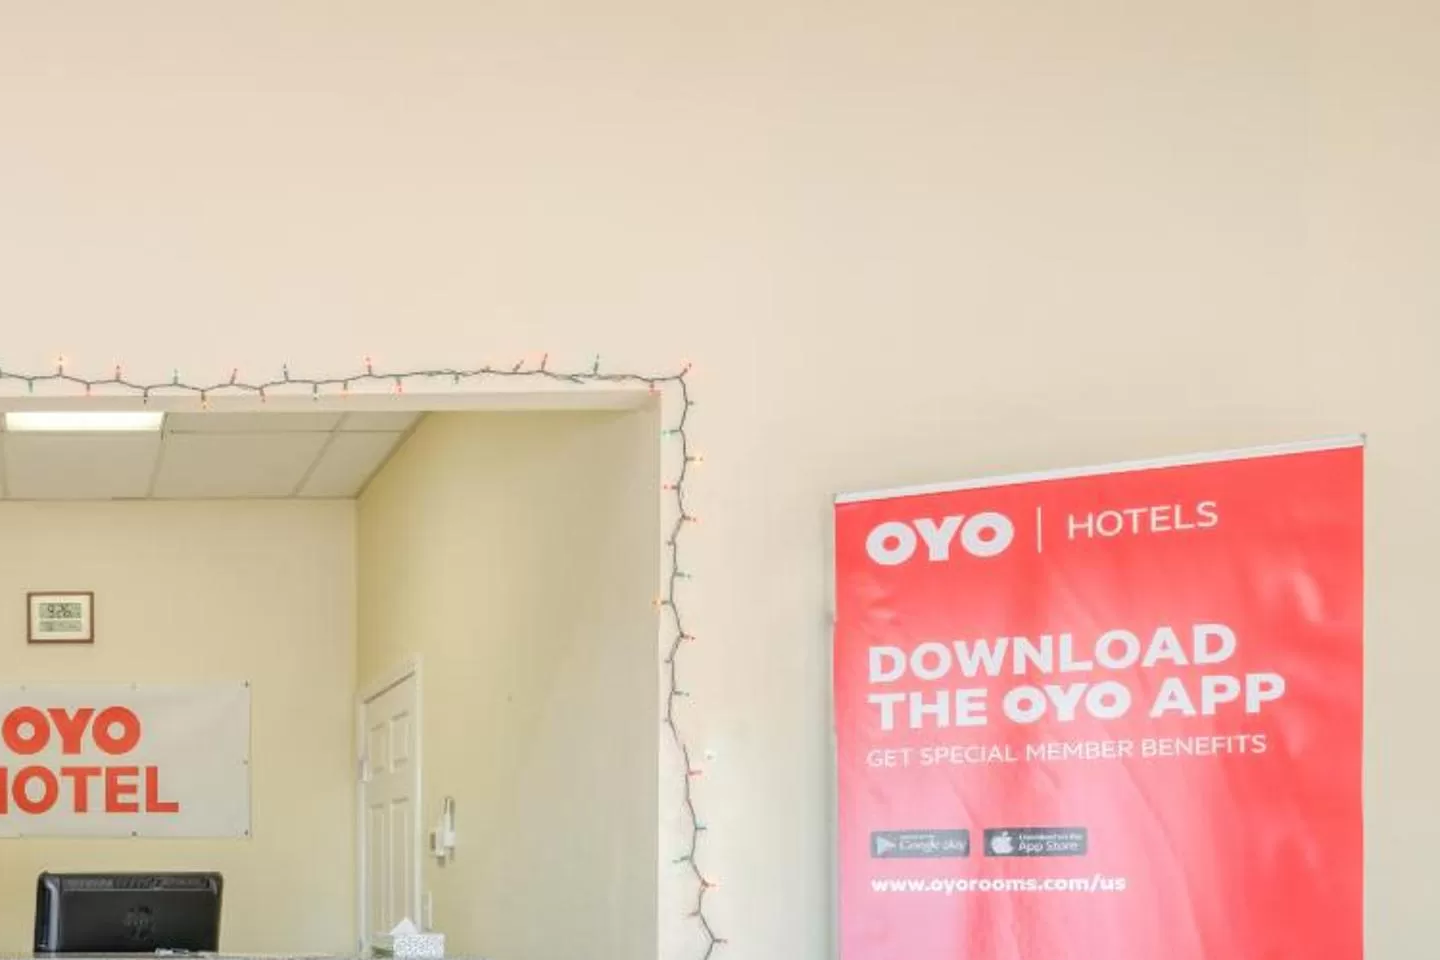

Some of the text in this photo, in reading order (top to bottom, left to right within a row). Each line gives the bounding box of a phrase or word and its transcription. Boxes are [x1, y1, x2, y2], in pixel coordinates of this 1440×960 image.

[865, 501, 1219, 566] OYO HOTELS
[867, 623, 1237, 683] DOWNLOAD
[867, 672, 1287, 731] THE OYO APP
[1, 705, 141, 755] OYO
[866, 733, 1269, 769] GET SPECIAL MEMBER BENEFITS
[1018, 839, 1079, 853] App Store
[870, 873, 1127, 897] www.oyorooms.com/us
